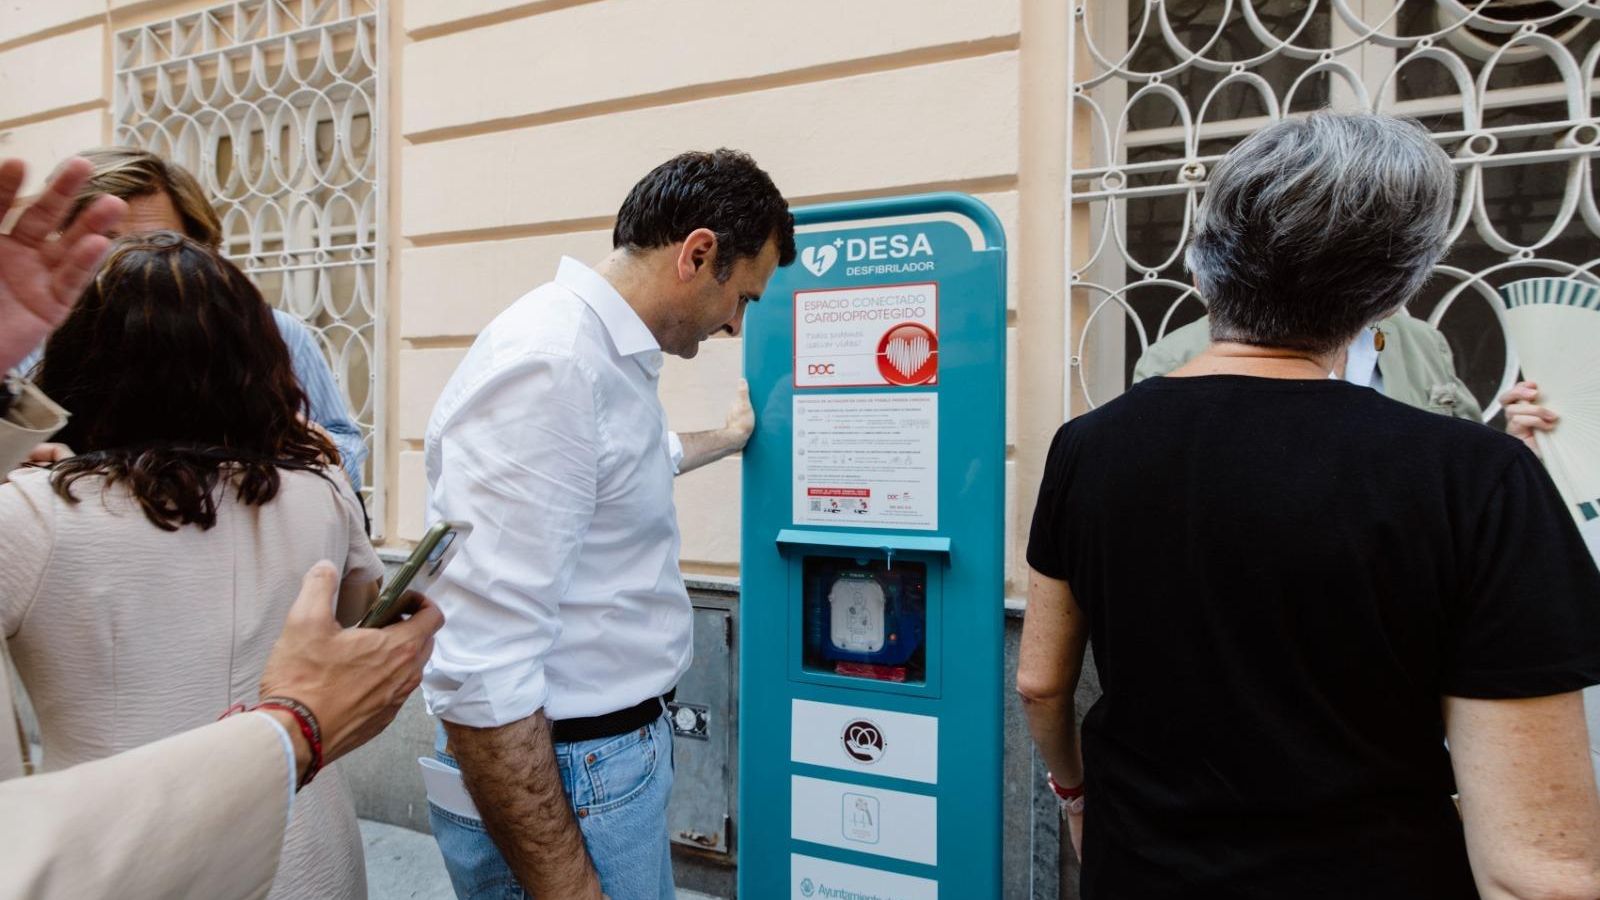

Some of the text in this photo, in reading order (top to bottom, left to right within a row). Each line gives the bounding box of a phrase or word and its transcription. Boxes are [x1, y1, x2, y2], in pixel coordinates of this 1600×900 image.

[846, 232, 934, 262] DESA
[846, 261, 935, 276] DESFIBRILADOR
[804, 294, 926, 311] ESPACIO CONECTADO
[804, 306, 926, 324] CARDIOPROTEGIDO
[807, 363, 835, 375] DOC
